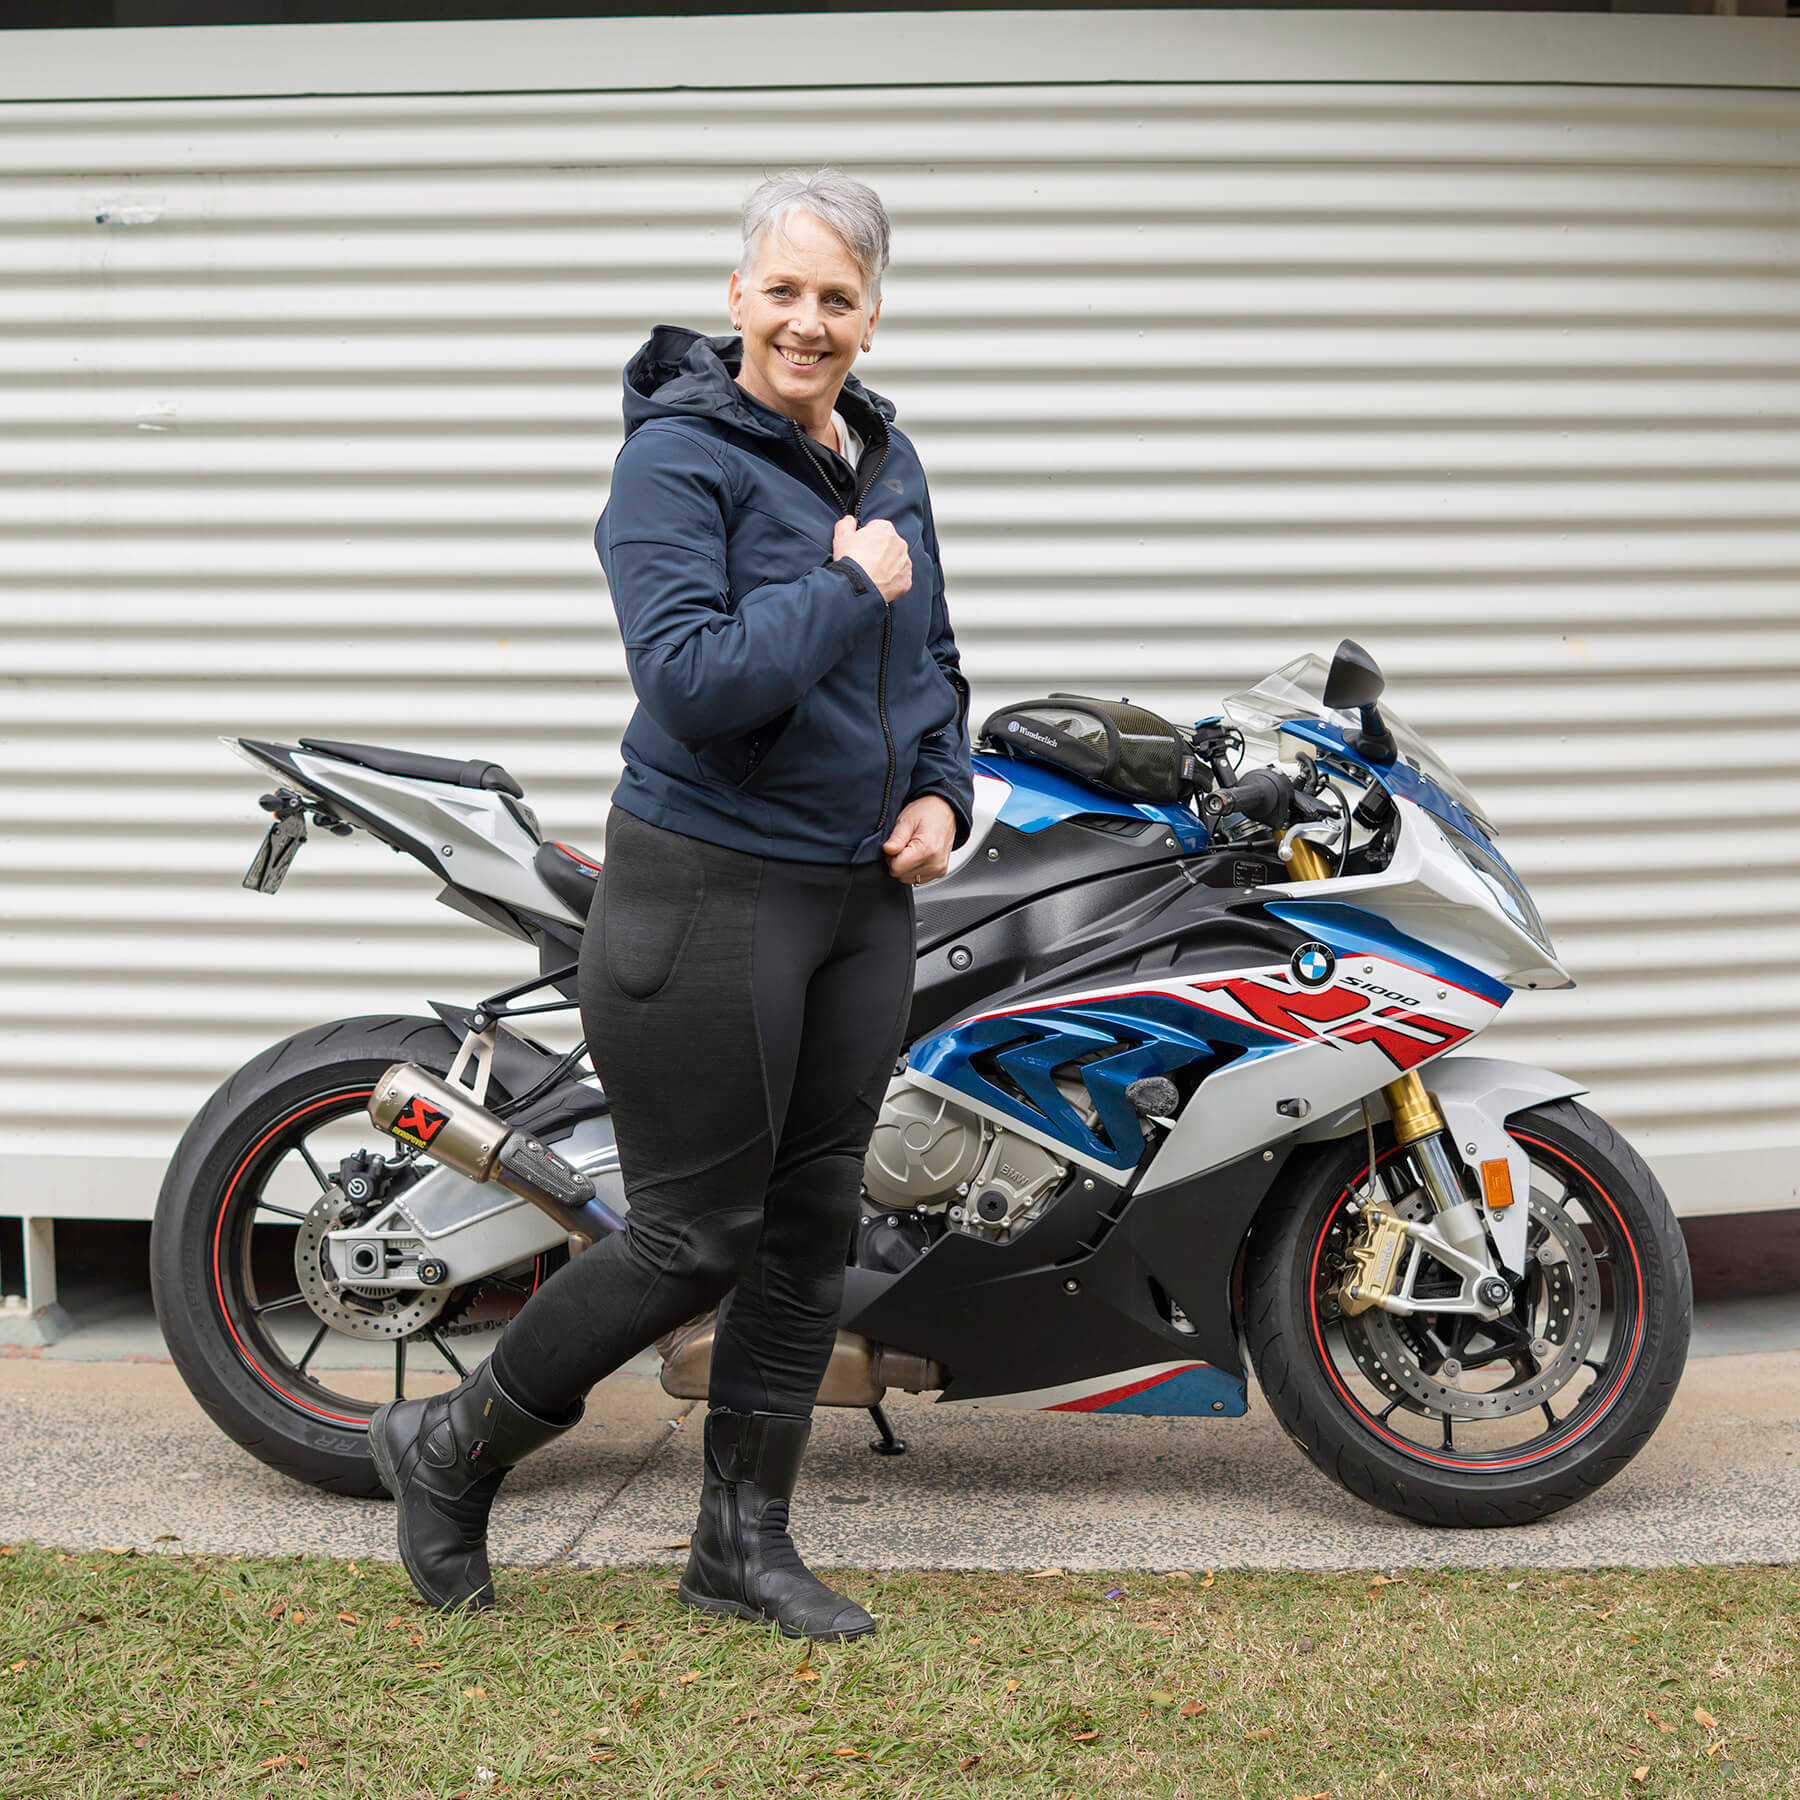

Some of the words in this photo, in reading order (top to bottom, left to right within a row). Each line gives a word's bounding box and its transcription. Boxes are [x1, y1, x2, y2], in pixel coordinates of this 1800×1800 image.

[1019, 726, 1058, 749] Wunderlich
[1339, 976, 1421, 1007] S1000
[1186, 972, 1475, 1073] RR
[1001, 1163, 1030, 1186] BMW
